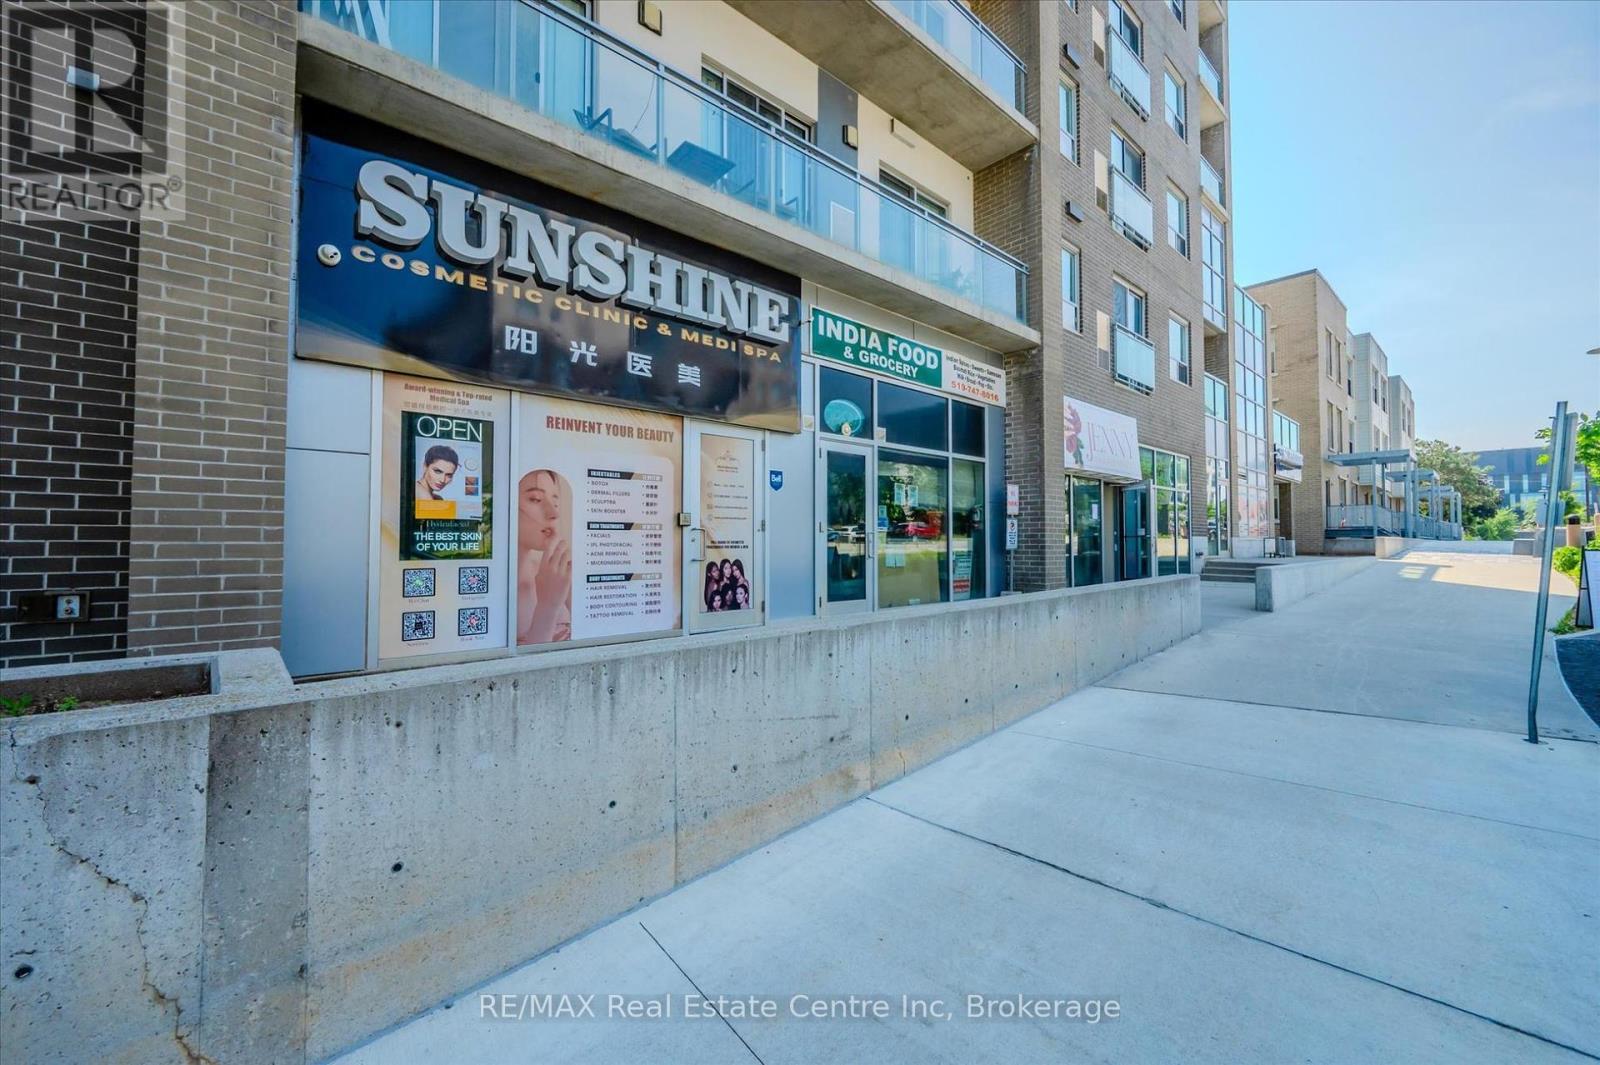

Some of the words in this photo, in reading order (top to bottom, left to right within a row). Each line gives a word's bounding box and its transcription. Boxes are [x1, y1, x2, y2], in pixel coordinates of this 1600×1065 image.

[355, 159, 790, 344] SUNSHINE
[351, 245, 544, 303] COSMETIC
[554, 296, 648, 330] CLINIC
[656, 322, 672, 337] &
[681, 328, 737, 353] MEDI
[743, 344, 782, 364] SPA
[817, 314, 882, 353] INDIA
[887, 336, 939, 370] FOOD
[843, 345, 854, 360] &
[858, 351, 919, 378] GROCERY
[417, 416, 483, 442] OPEN
[546, 415, 602, 435] REINVENT
[605, 423, 634, 439] YOUR
[637, 428, 674, 443] BEAUTY
[414, 532, 434, 541] THE
[435, 532, 460, 541] BEST
[461, 532, 482, 541] SKIN
[416, 543, 431, 551] OF
[432, 542, 459, 551] YOUR
[461, 542, 480, 551] LIFE
